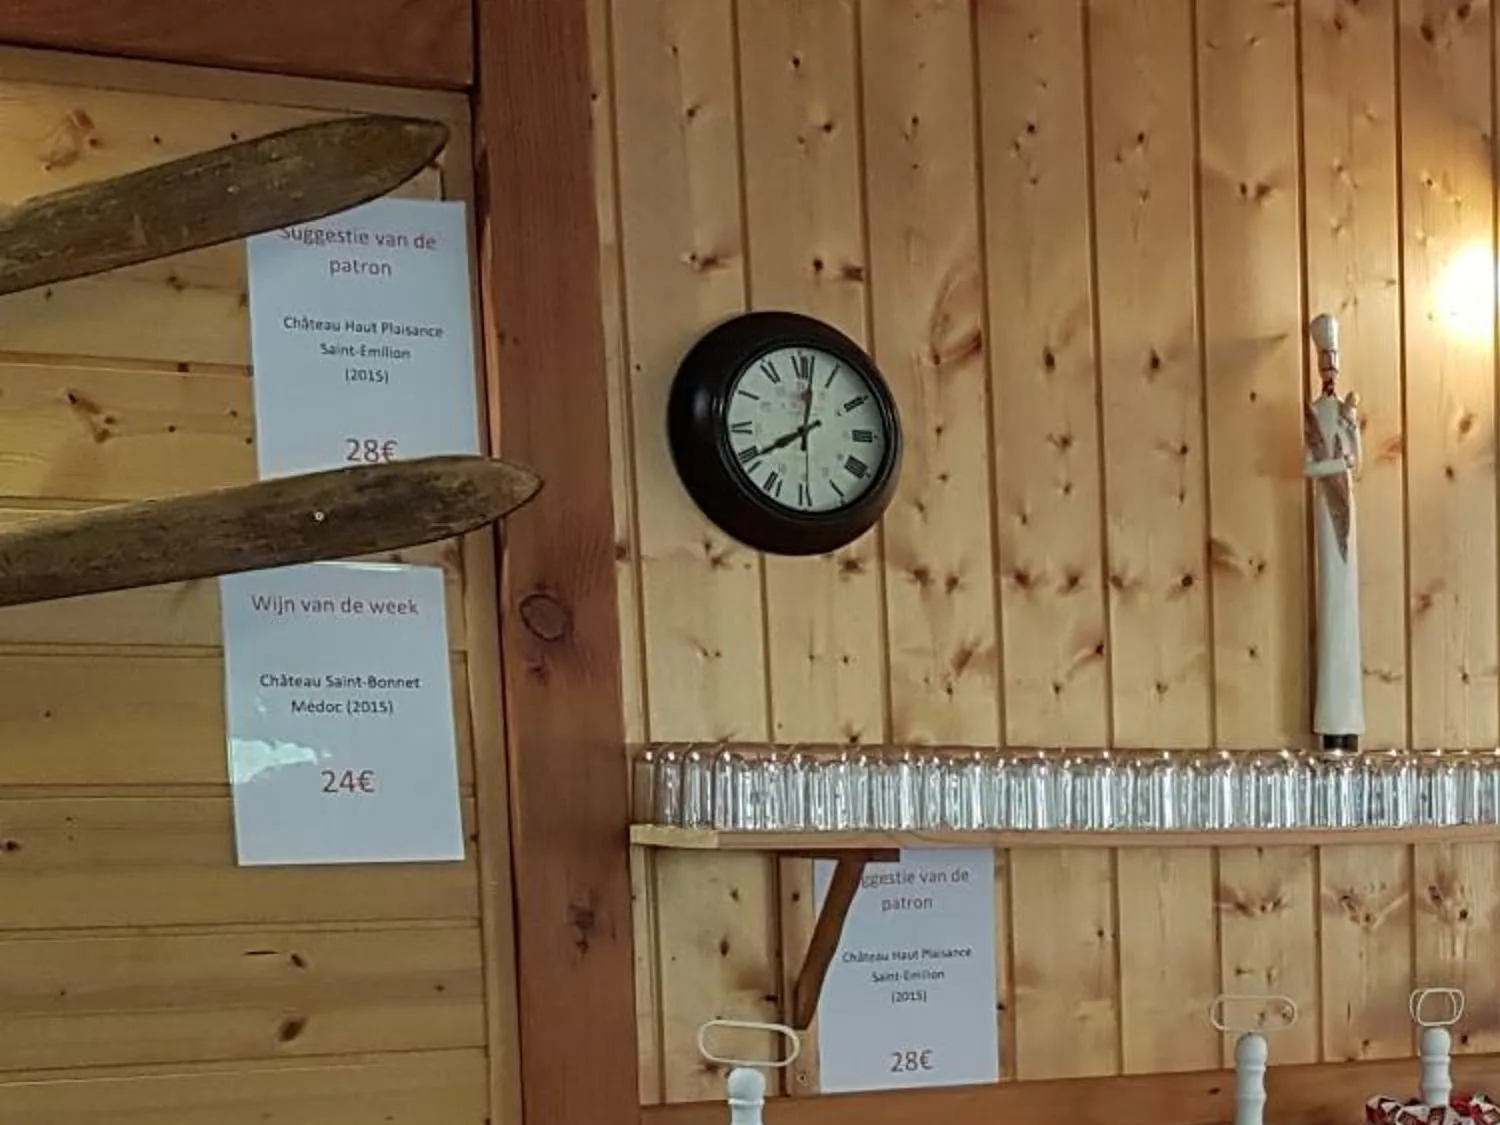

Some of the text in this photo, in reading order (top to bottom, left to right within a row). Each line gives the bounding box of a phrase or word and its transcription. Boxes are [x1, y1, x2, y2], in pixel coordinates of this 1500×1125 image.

[280, 226, 437, 250] Suggestie van de
[329, 259, 392, 277] patron
[283, 315, 444, 338] Château Haut Plaisance
[345, 367, 390, 385] (2015)
[345, 438, 398, 464] 28€
[251, 595, 420, 616] Wijn van de week
[259, 672, 421, 689] Château Saint-Bonnet
[346, 700, 394, 715] (2015)
[320, 769, 376, 794] 24€
[919, 869, 948, 885] van
[951, 866, 969, 883] de
[881, 896, 933, 912] patron
[891, 1049, 934, 1073] 28€
